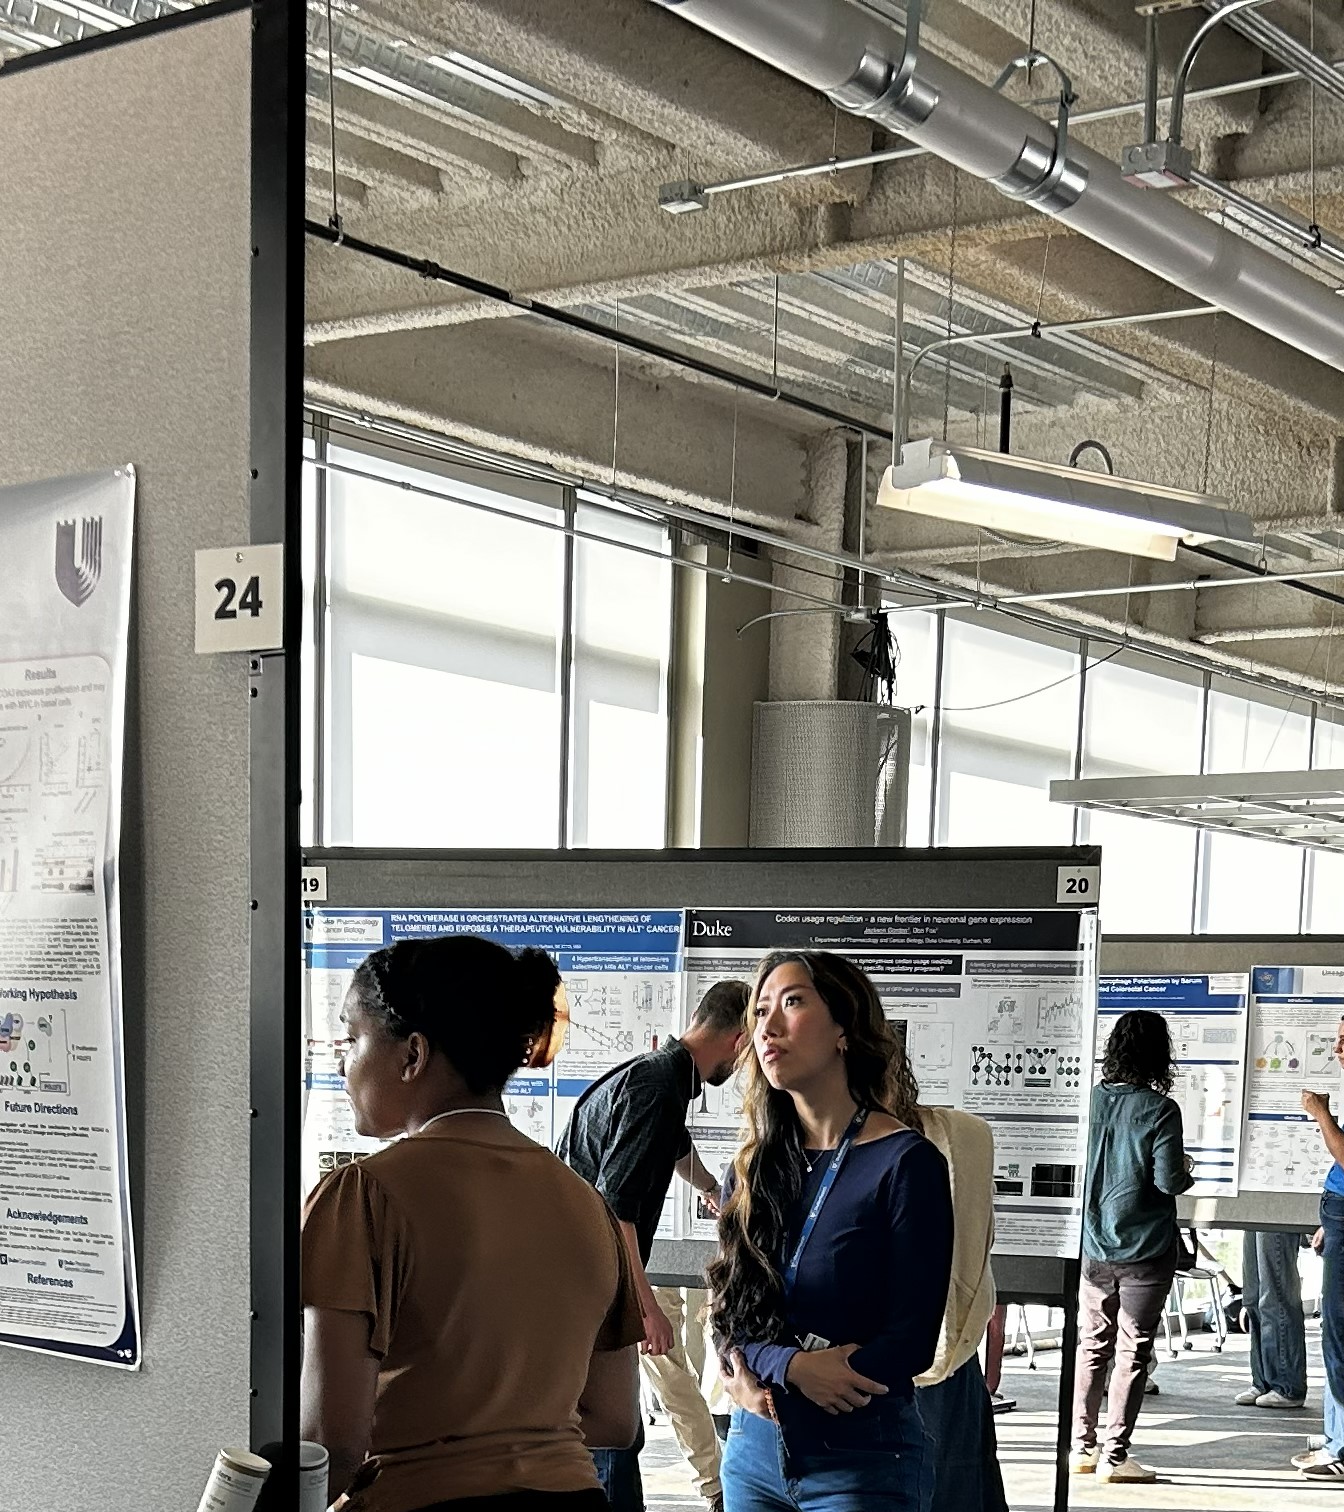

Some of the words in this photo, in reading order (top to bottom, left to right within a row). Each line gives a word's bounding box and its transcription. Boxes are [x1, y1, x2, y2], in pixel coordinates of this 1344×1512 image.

[214, 575, 264, 620] 24
[301, 877, 320, 892] 19
[1066, 877, 1089, 894] 20
[692, 920, 733, 937] Duke
[29, 988, 78, 1001] Hypothesis
[4, 1101, 32, 1113] Future
[34, 1103, 78, 1115] Directions
[6, 1207, 89, 1225] Acknowledgements
[27, 1272, 74, 1289] References
